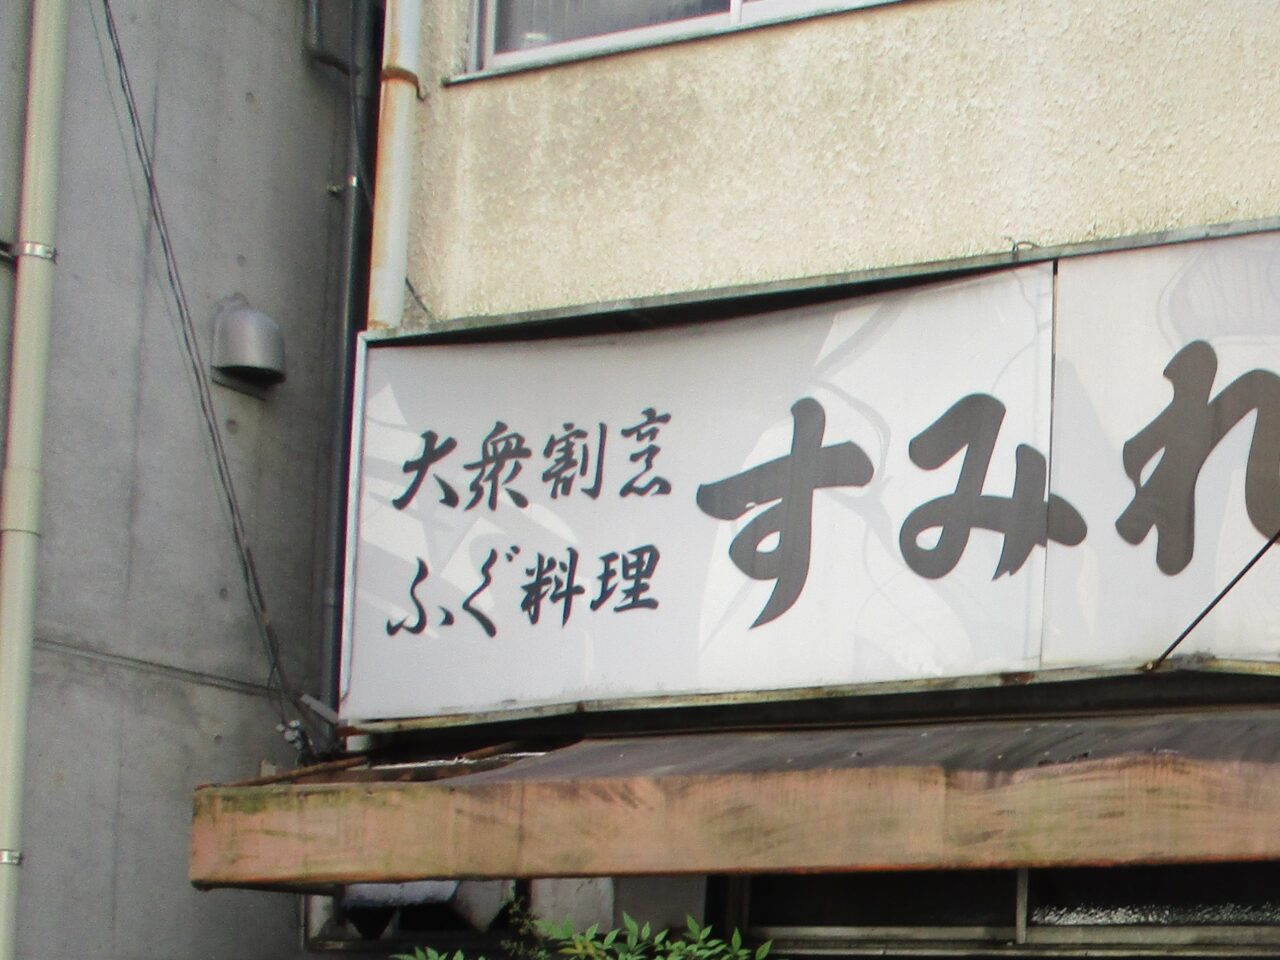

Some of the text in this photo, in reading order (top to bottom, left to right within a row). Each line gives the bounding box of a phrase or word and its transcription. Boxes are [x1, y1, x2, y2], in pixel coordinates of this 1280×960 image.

[391, 407, 674, 513] 大衆割烹
[386, 543, 661, 639] ふぐ料理
